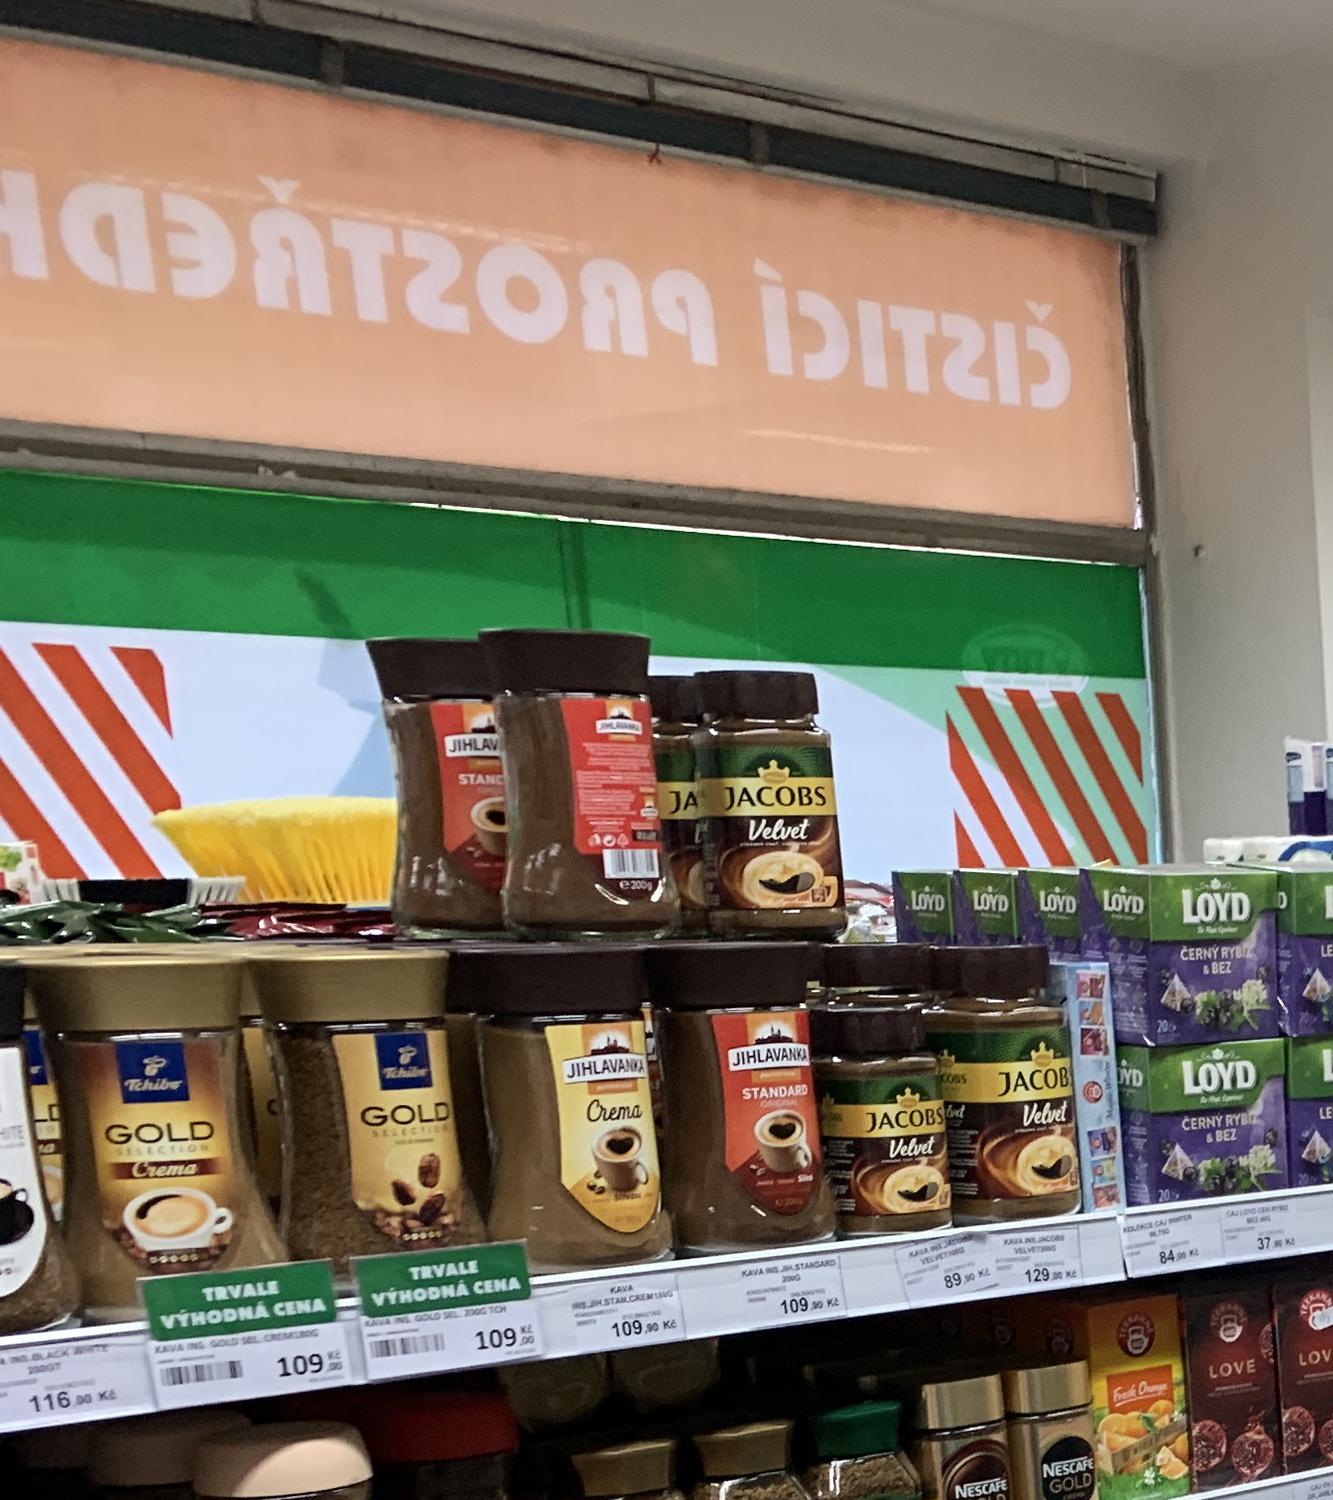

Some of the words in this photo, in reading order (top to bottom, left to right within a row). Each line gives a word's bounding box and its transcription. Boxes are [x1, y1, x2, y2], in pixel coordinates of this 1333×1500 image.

[725, 785, 827, 810] JACOBS
[748, 818, 809, 842] Velvet
[1212, 960, 1232, 974] BEZ
[567, 1054, 646, 1077] JIHLAVANKA
[733, 1047, 808, 1067] JIHLAVANKA
[382, 1065, 430, 1081] Tchibo
[1183, 1060, 1256, 1096] LOYD
[124, 1076, 183, 1093] Tchibo
[742, 1084, 808, 1100] STANDARD
[360, 1102, 450, 1127] GOLD
[587, 1100, 643, 1122] Crema
[865, 1108, 943, 1133] JACOBS
[1023, 1103, 1068, 1125] Velvet
[104, 1121, 215, 1145] GOLD
[888, 1137, 935, 1157] Velvet
[132, 1160, 199, 1178] Crema
[409, 1260, 479, 1280] TRVALE
[202, 1281, 279, 1302] TRVALE
[371, 1280, 470, 1307] VÝHODNÁ
[474, 1275, 521, 1295] CENA
[160, 1302, 268, 1331] VÝHODNÁ
[272, 1295, 326, 1317] CENA
[475, 1327, 517, 1351] 109
[277, 1354, 324, 1379] 109
[1209, 1359, 1256, 1378] LOVE
[1048, 1473, 1093, 1493] GOLD
